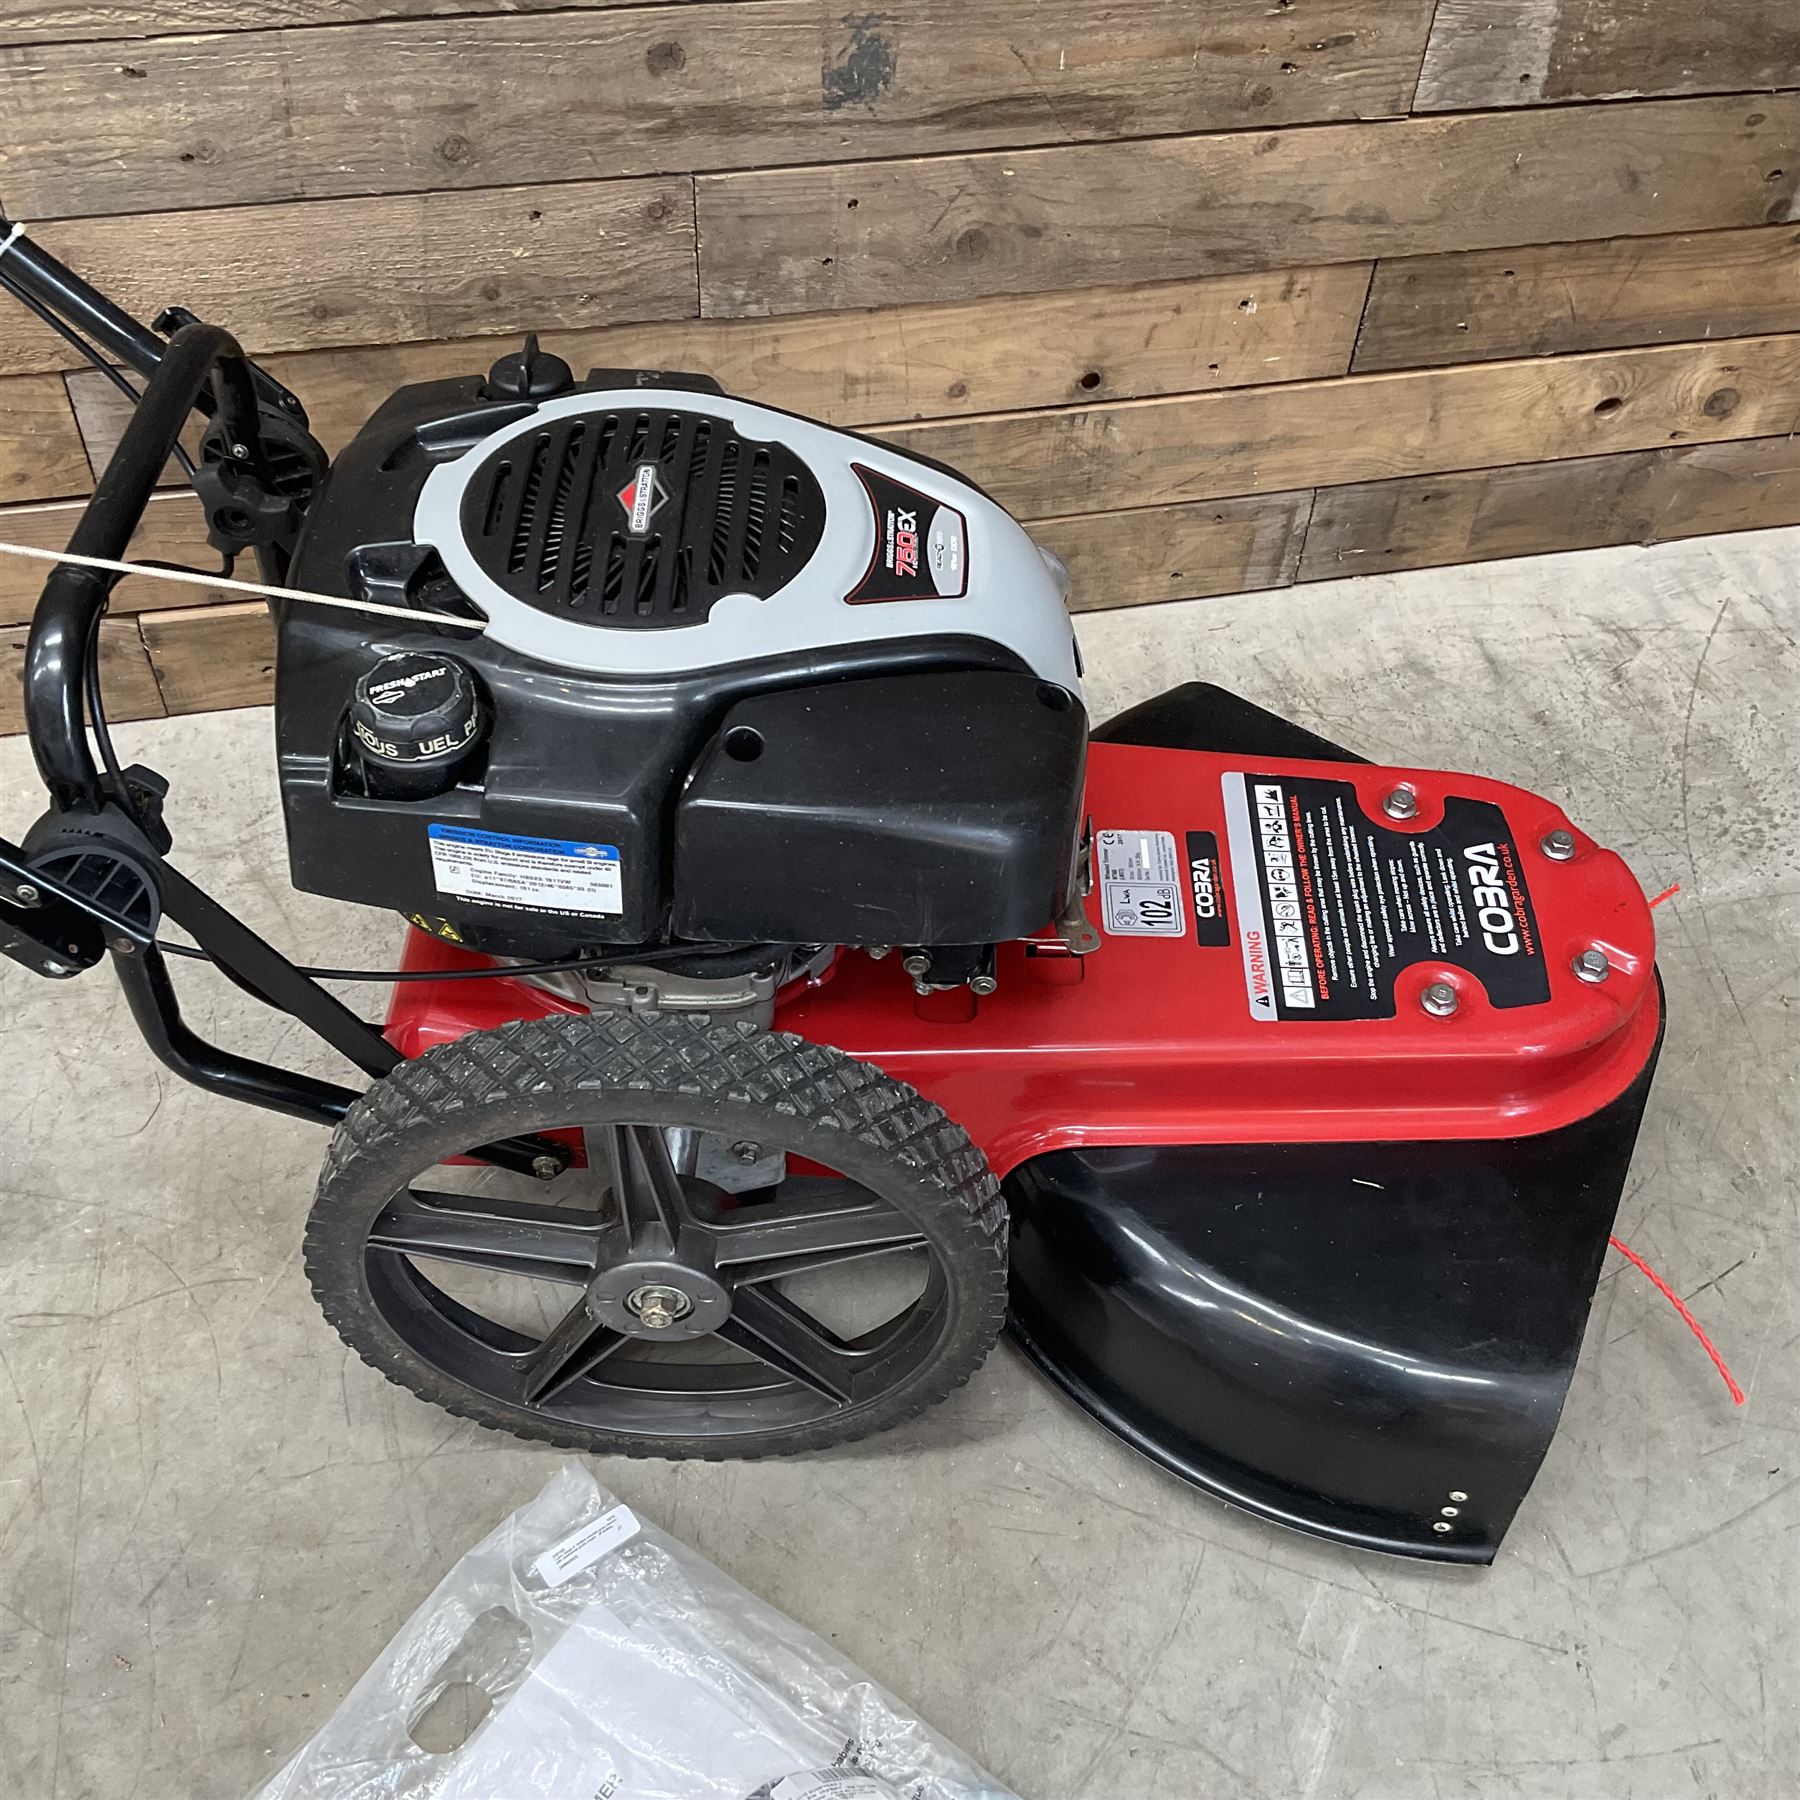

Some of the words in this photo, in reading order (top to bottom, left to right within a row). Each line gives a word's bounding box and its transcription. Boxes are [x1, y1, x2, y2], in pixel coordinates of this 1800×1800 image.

[370, 678, 405, 694] FRESH
[411, 667, 447, 680] START
[418, 734, 459, 755] UEL
[1289, 794, 1300, 821] MANUAL
[1294, 822, 1305, 852] OWNER'S
[1366, 834, 1377, 857] operating.
[1408, 840, 1418, 857] guards
[1416, 841, 1428, 862] correctly.
[1434, 848, 1442, 857] and
[1299, 853, 1307, 866] THE
[1370, 858, 1378, 870] when
[1387, 858, 1397, 875] slopes:
[1395, 858, 1404, 872] down.
[1436, 857, 1445, 870] down
[1445, 856, 1457, 880] operating.
[1398, 873, 1406, 882] and
[1413, 863, 1421, 875] such
[1421, 862, 1432, 880] operate
[1440, 871, 1448, 883] Look
[1192, 858, 1215, 917] COBRA
[1301, 867, 1312, 896] FOLLOW
[1373, 871, 1385, 894] protection
[1391, 876, 1401, 893] mowing
[1416, 875, 1426, 894] devices,
[1425, 880, 1433, 890] and
[1450, 880, 1459, 894] whilst
[1378, 895, 1387, 904] eye
[1394, 894, 1402, 907] when
[1420, 895, 1430, 910] safety
[1427, 891, 1437, 903] place
[1442, 884, 1455, 907] operating:
[1464, 842, 1519, 955] COBRA
[1497, 843, 1535, 956] www.cobragarden.co.uk
[1139, 901, 1173, 926] 102
[1157, 889, 1170, 899] dB
[1307, 904, 1317, 923] READ
[1379, 904, 1389, 918] safety
[1405, 904, 1414, 919] across
[1448, 907, 1457, 921] whilst
[1456, 904, 1465, 920] before
[1382, 919, 1394, 942] approved
[1399, 920, 1407, 931] Take
[1408, 920, 1416, 932] Mow
[1426, 917, 1434, 934] ensure
[1433, 919, 1444, 942] deflectors
[1452, 922, 1460, 933] care
[1460, 921, 1469, 937] behind
[1310, 925, 1324, 967] OPERATING:
[1428, 935, 1439, 952] Always
[1439, 943, 1447, 953] and
[1454, 934, 1463, 946] Take
[1387, 943, 1395, 957] Wear
[1247, 931, 1268, 994] WARNING
[1317, 969, 1329, 999] BEFORE
